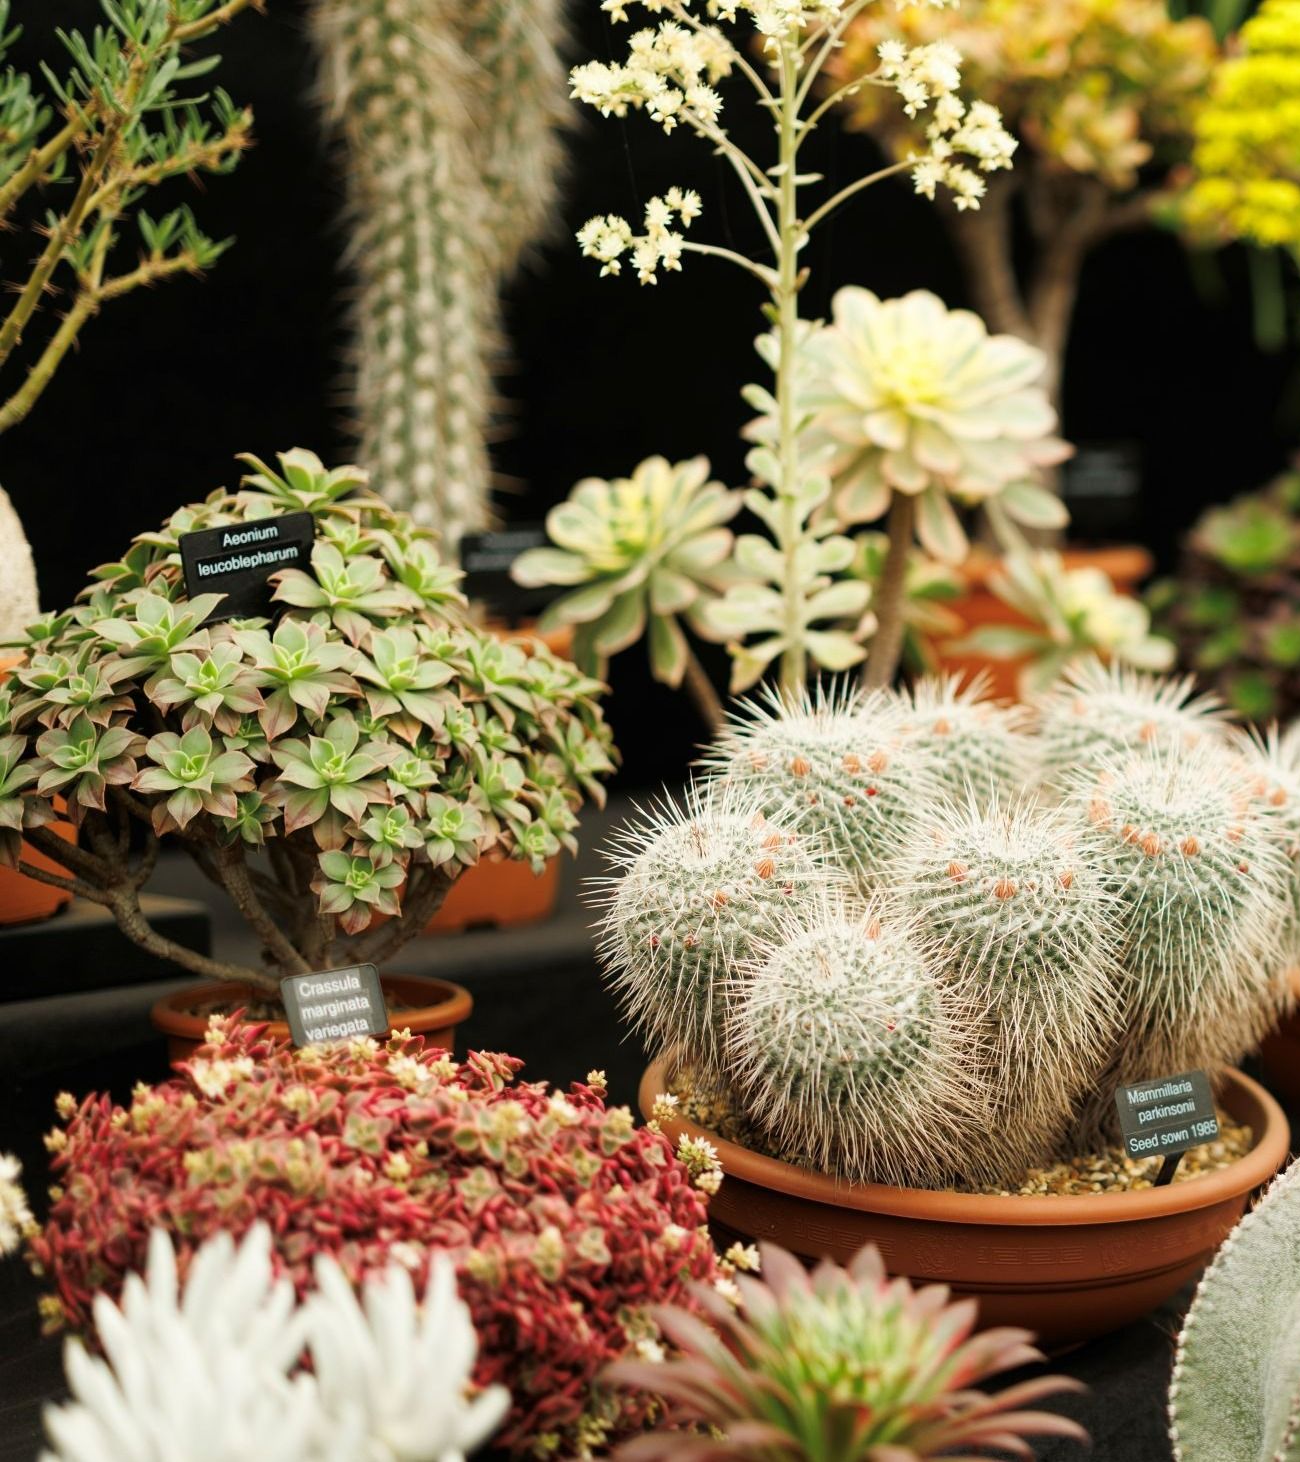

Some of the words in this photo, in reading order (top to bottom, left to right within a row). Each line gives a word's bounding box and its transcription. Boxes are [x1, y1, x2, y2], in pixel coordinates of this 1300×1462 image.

[222, 525, 279, 548] Aeonium
[197, 545, 299, 577] leucoblepharum
[299, 975, 361, 998] Crassula
[301, 996, 370, 1020] marginata
[305, 1018, 369, 1041] variegata
[1127, 1079, 1193, 1105] Mammillaria
[1138, 1097, 1196, 1125] parkinsonii
[1129, 1133, 1159, 1152] Seed
[1160, 1128, 1189, 1145] sown
[1190, 1119, 1218, 1138] 1985
